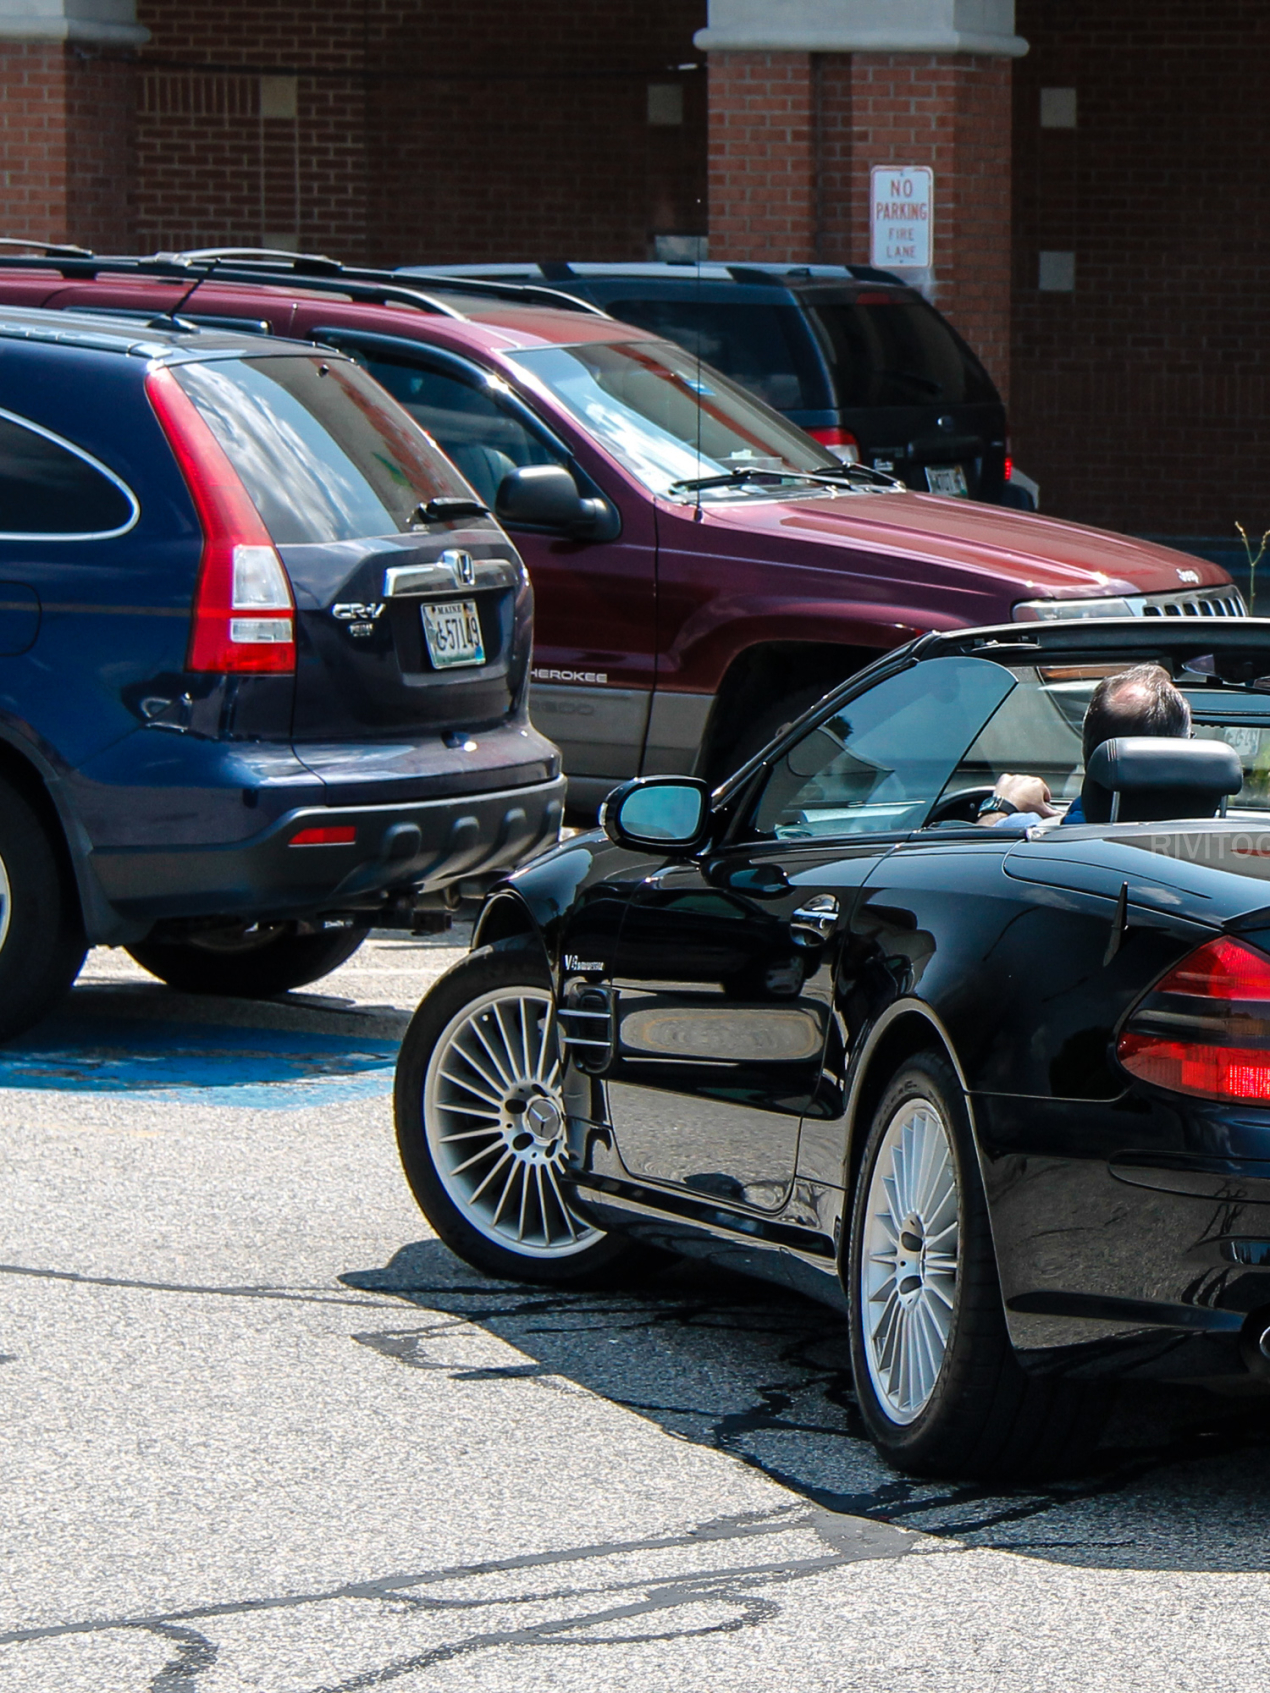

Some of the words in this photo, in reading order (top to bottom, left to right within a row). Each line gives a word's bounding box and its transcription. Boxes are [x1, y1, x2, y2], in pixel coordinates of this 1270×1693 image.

[890, 179, 913, 197] NO
[876, 202, 928, 220] PARKING
[888, 227, 915, 242] FIRE
[886, 245, 916, 258] LANE
[332, 603, 386, 619] CR-V
[437, 604, 462, 614] MAINE
[445, 616, 480, 649] 57149
